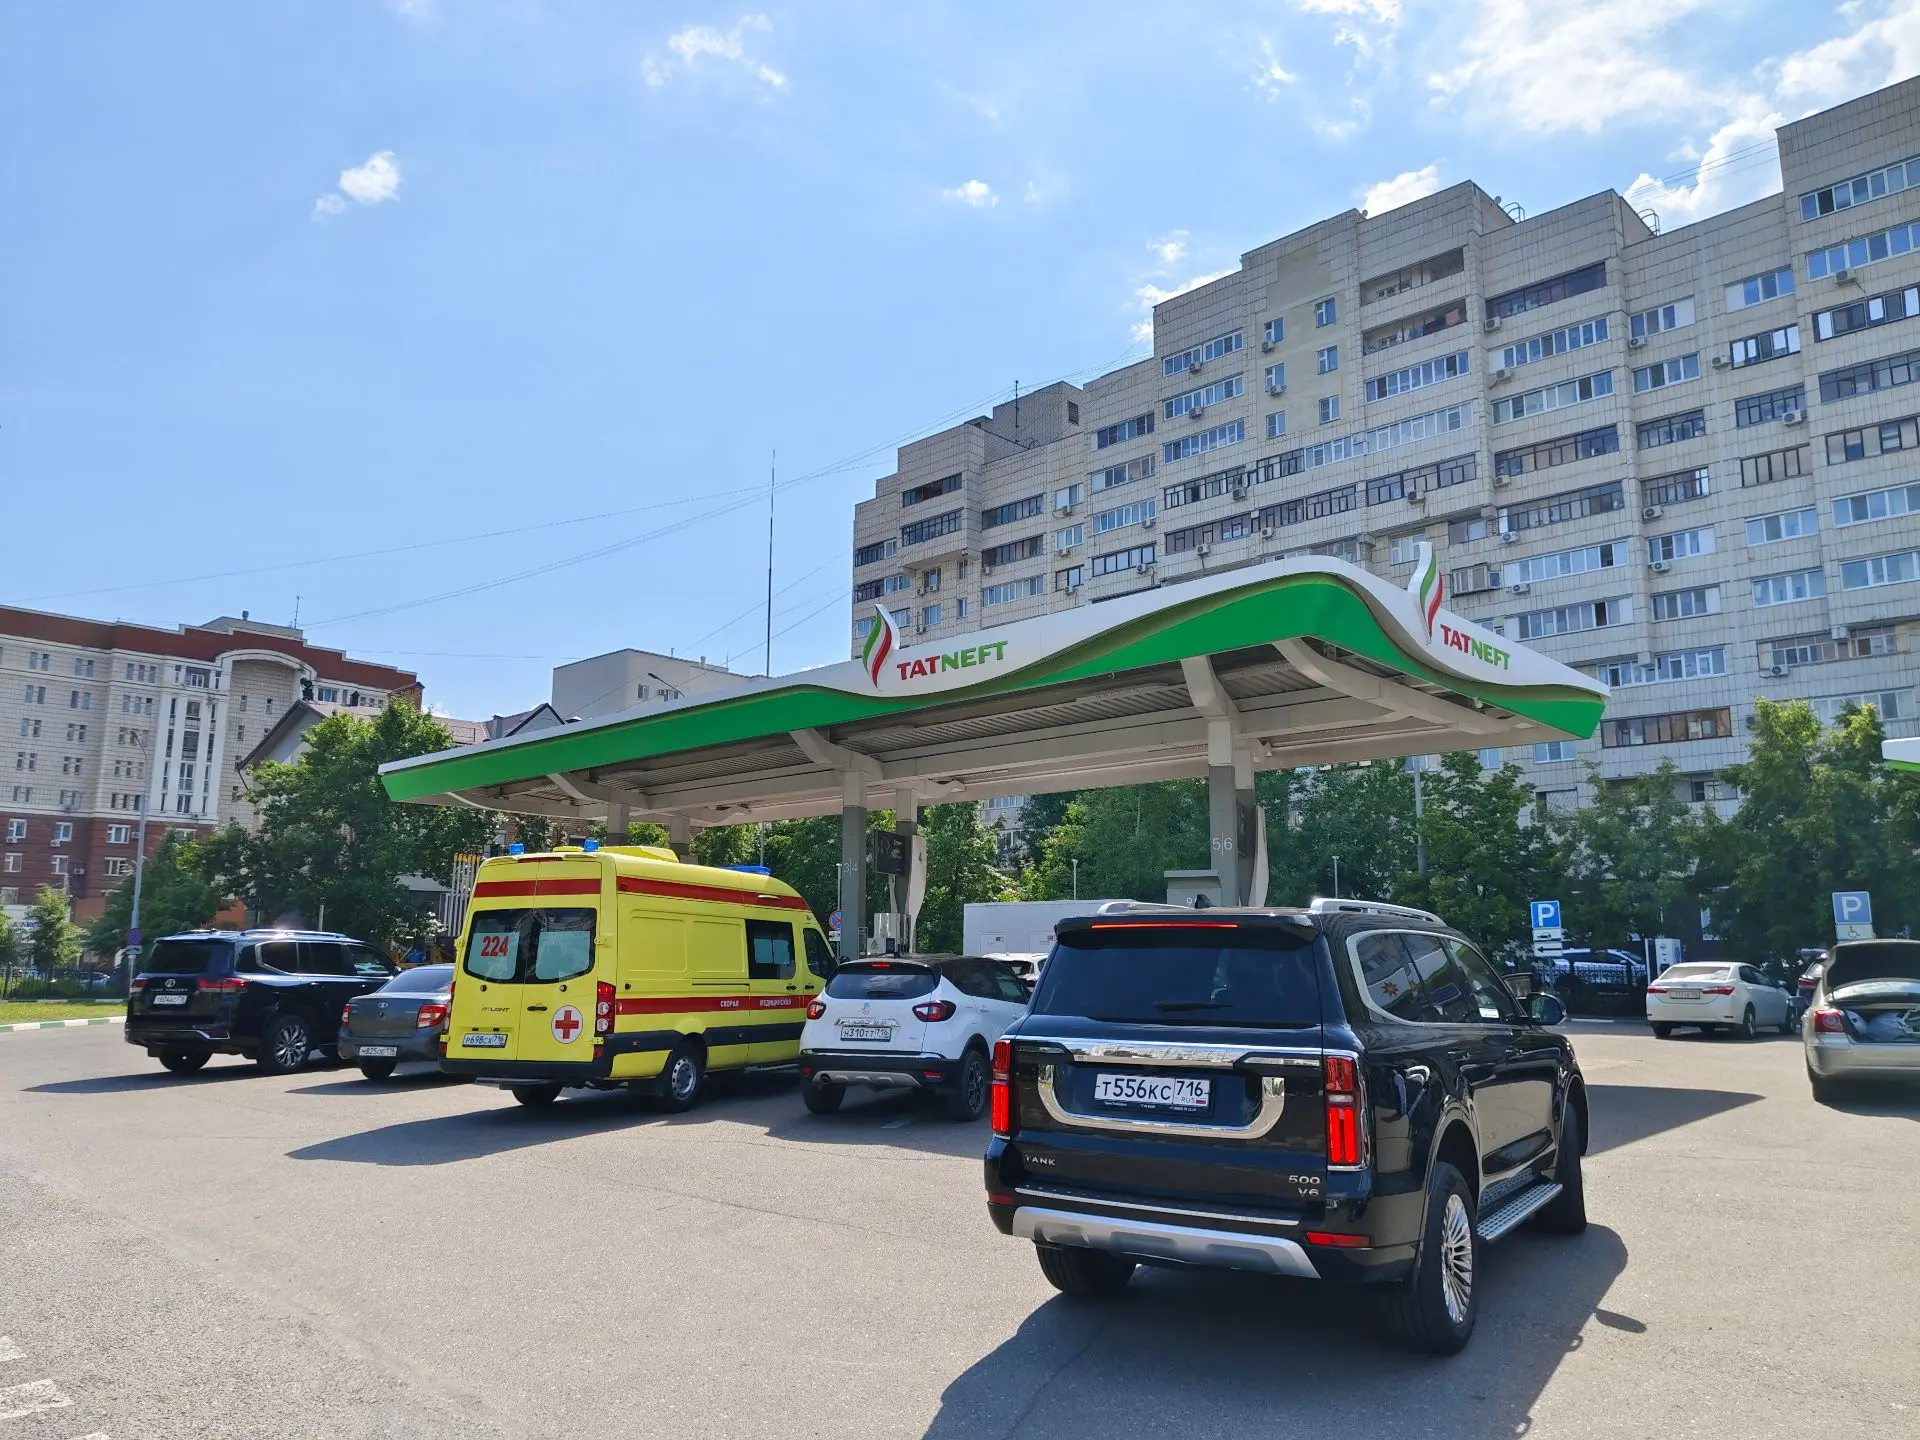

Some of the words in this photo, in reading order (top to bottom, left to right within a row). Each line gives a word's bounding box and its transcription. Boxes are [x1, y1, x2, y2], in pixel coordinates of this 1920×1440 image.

[1440, 623, 1511, 671] TATNEFT
[897, 640, 1008, 681] TATNEFT
[1537, 903, 1555, 927] P
[1841, 896, 1861, 920] P
[481, 935, 509, 956] 224
[1181, 1096, 1196, 1104] RUS
[1024, 1154, 1056, 1166] TANK
[1288, 1175, 1321, 1184] 500
[1297, 1187, 1319, 1197] V6
